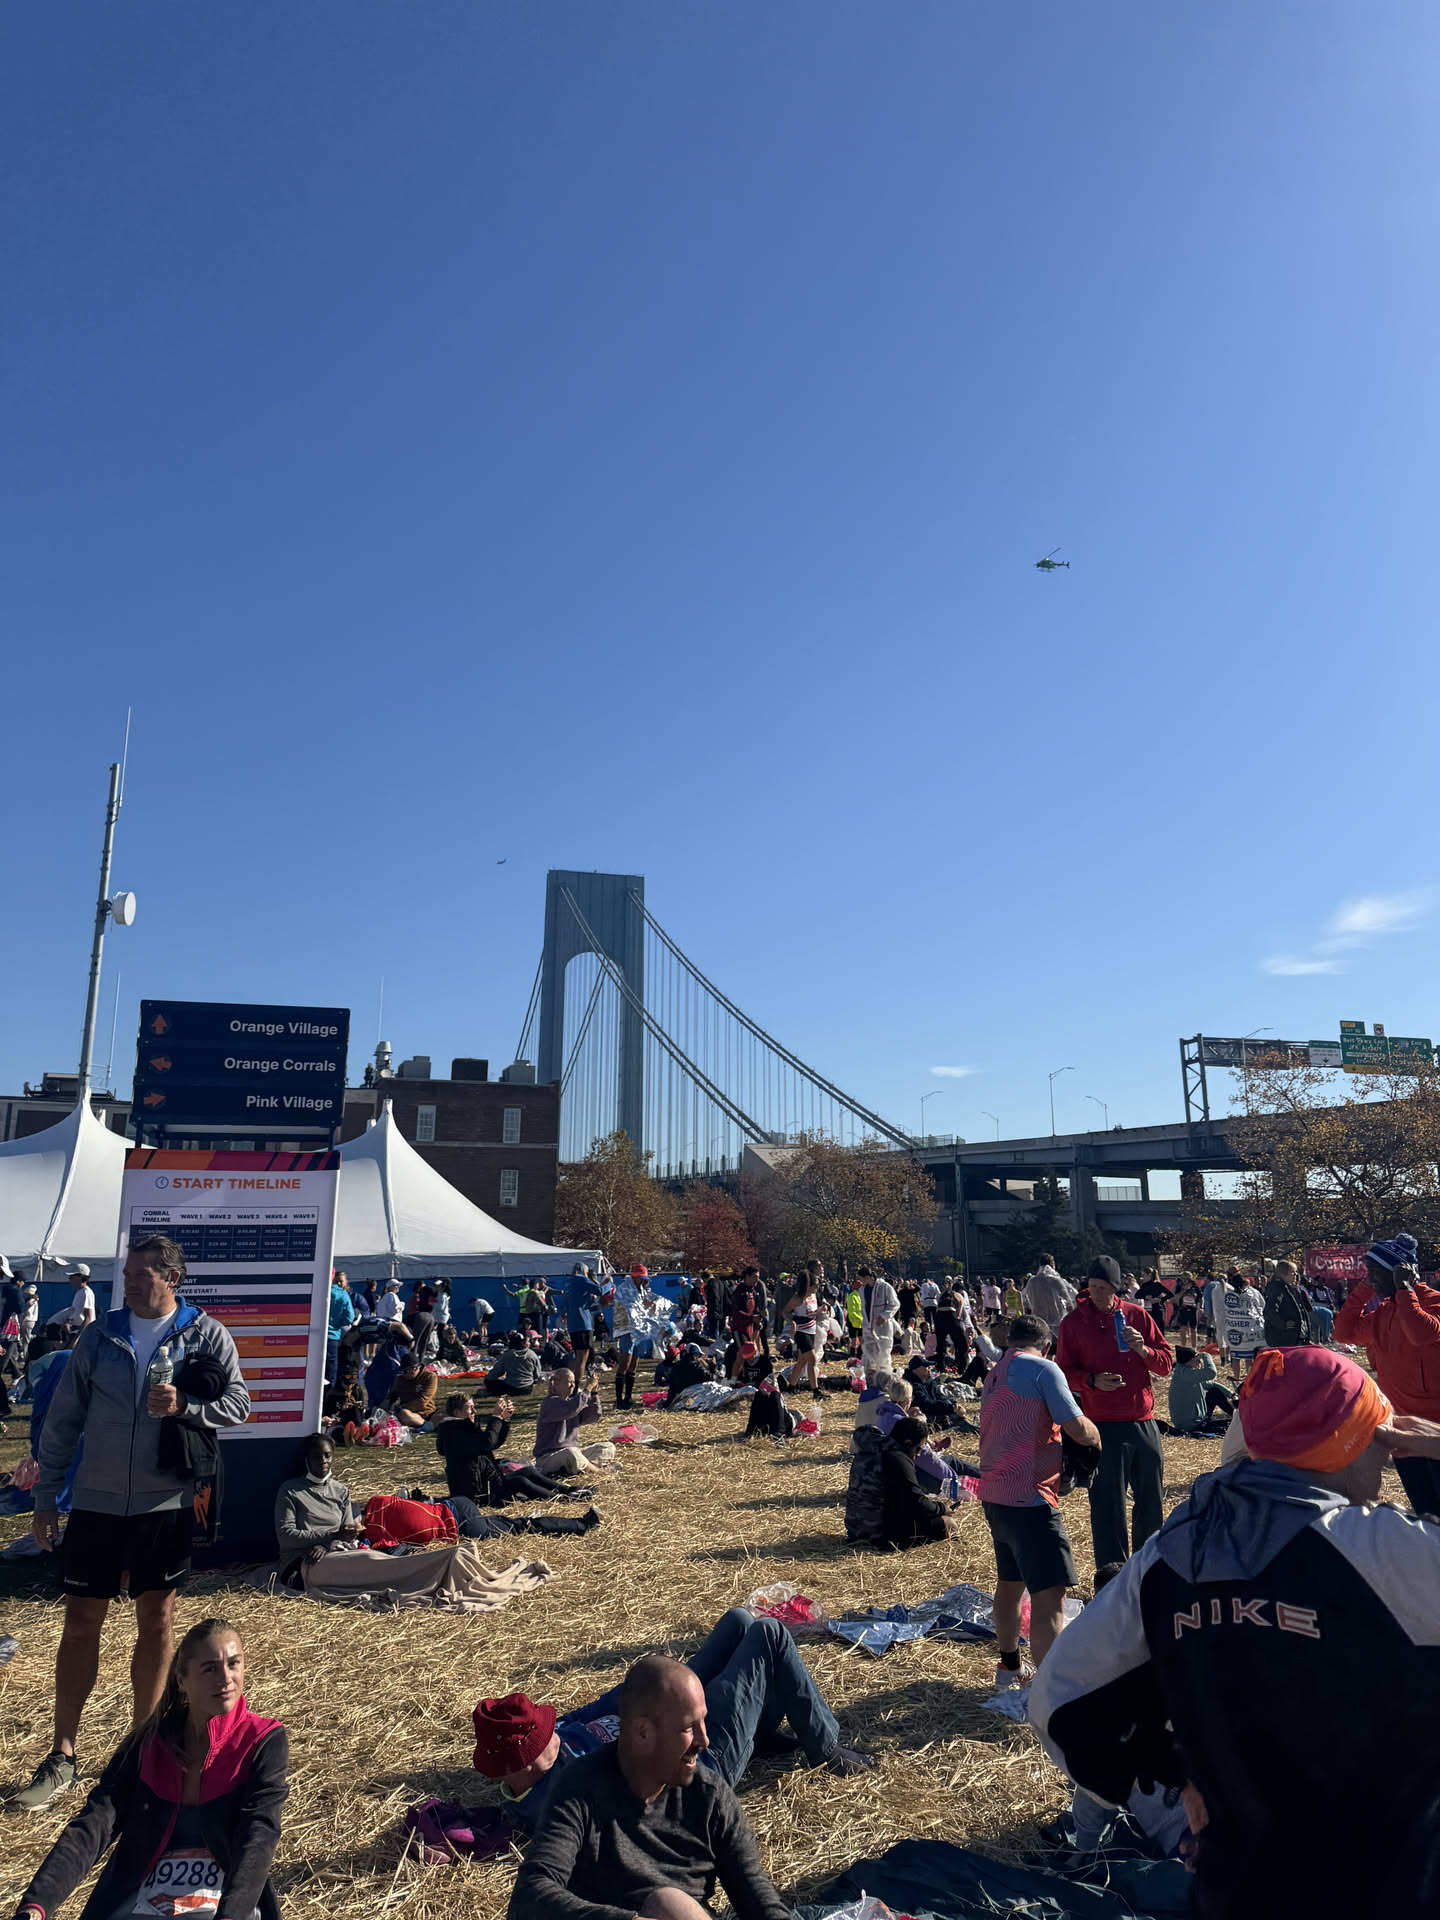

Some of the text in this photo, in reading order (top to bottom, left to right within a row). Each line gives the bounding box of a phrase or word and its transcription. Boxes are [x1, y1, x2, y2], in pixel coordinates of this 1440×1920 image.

[230, 1020, 338, 1038] Orange Village
[224, 1057, 336, 1074] Orange Corrals
[246, 1094, 333, 1112] Pink Village
[172, 1178, 302, 1190] START TIMELINE
[1315, 1256, 1354, 1270] Corral
[1173, 1598, 1321, 1639] NIKE
[144, 1860, 220, 1888] 49288
